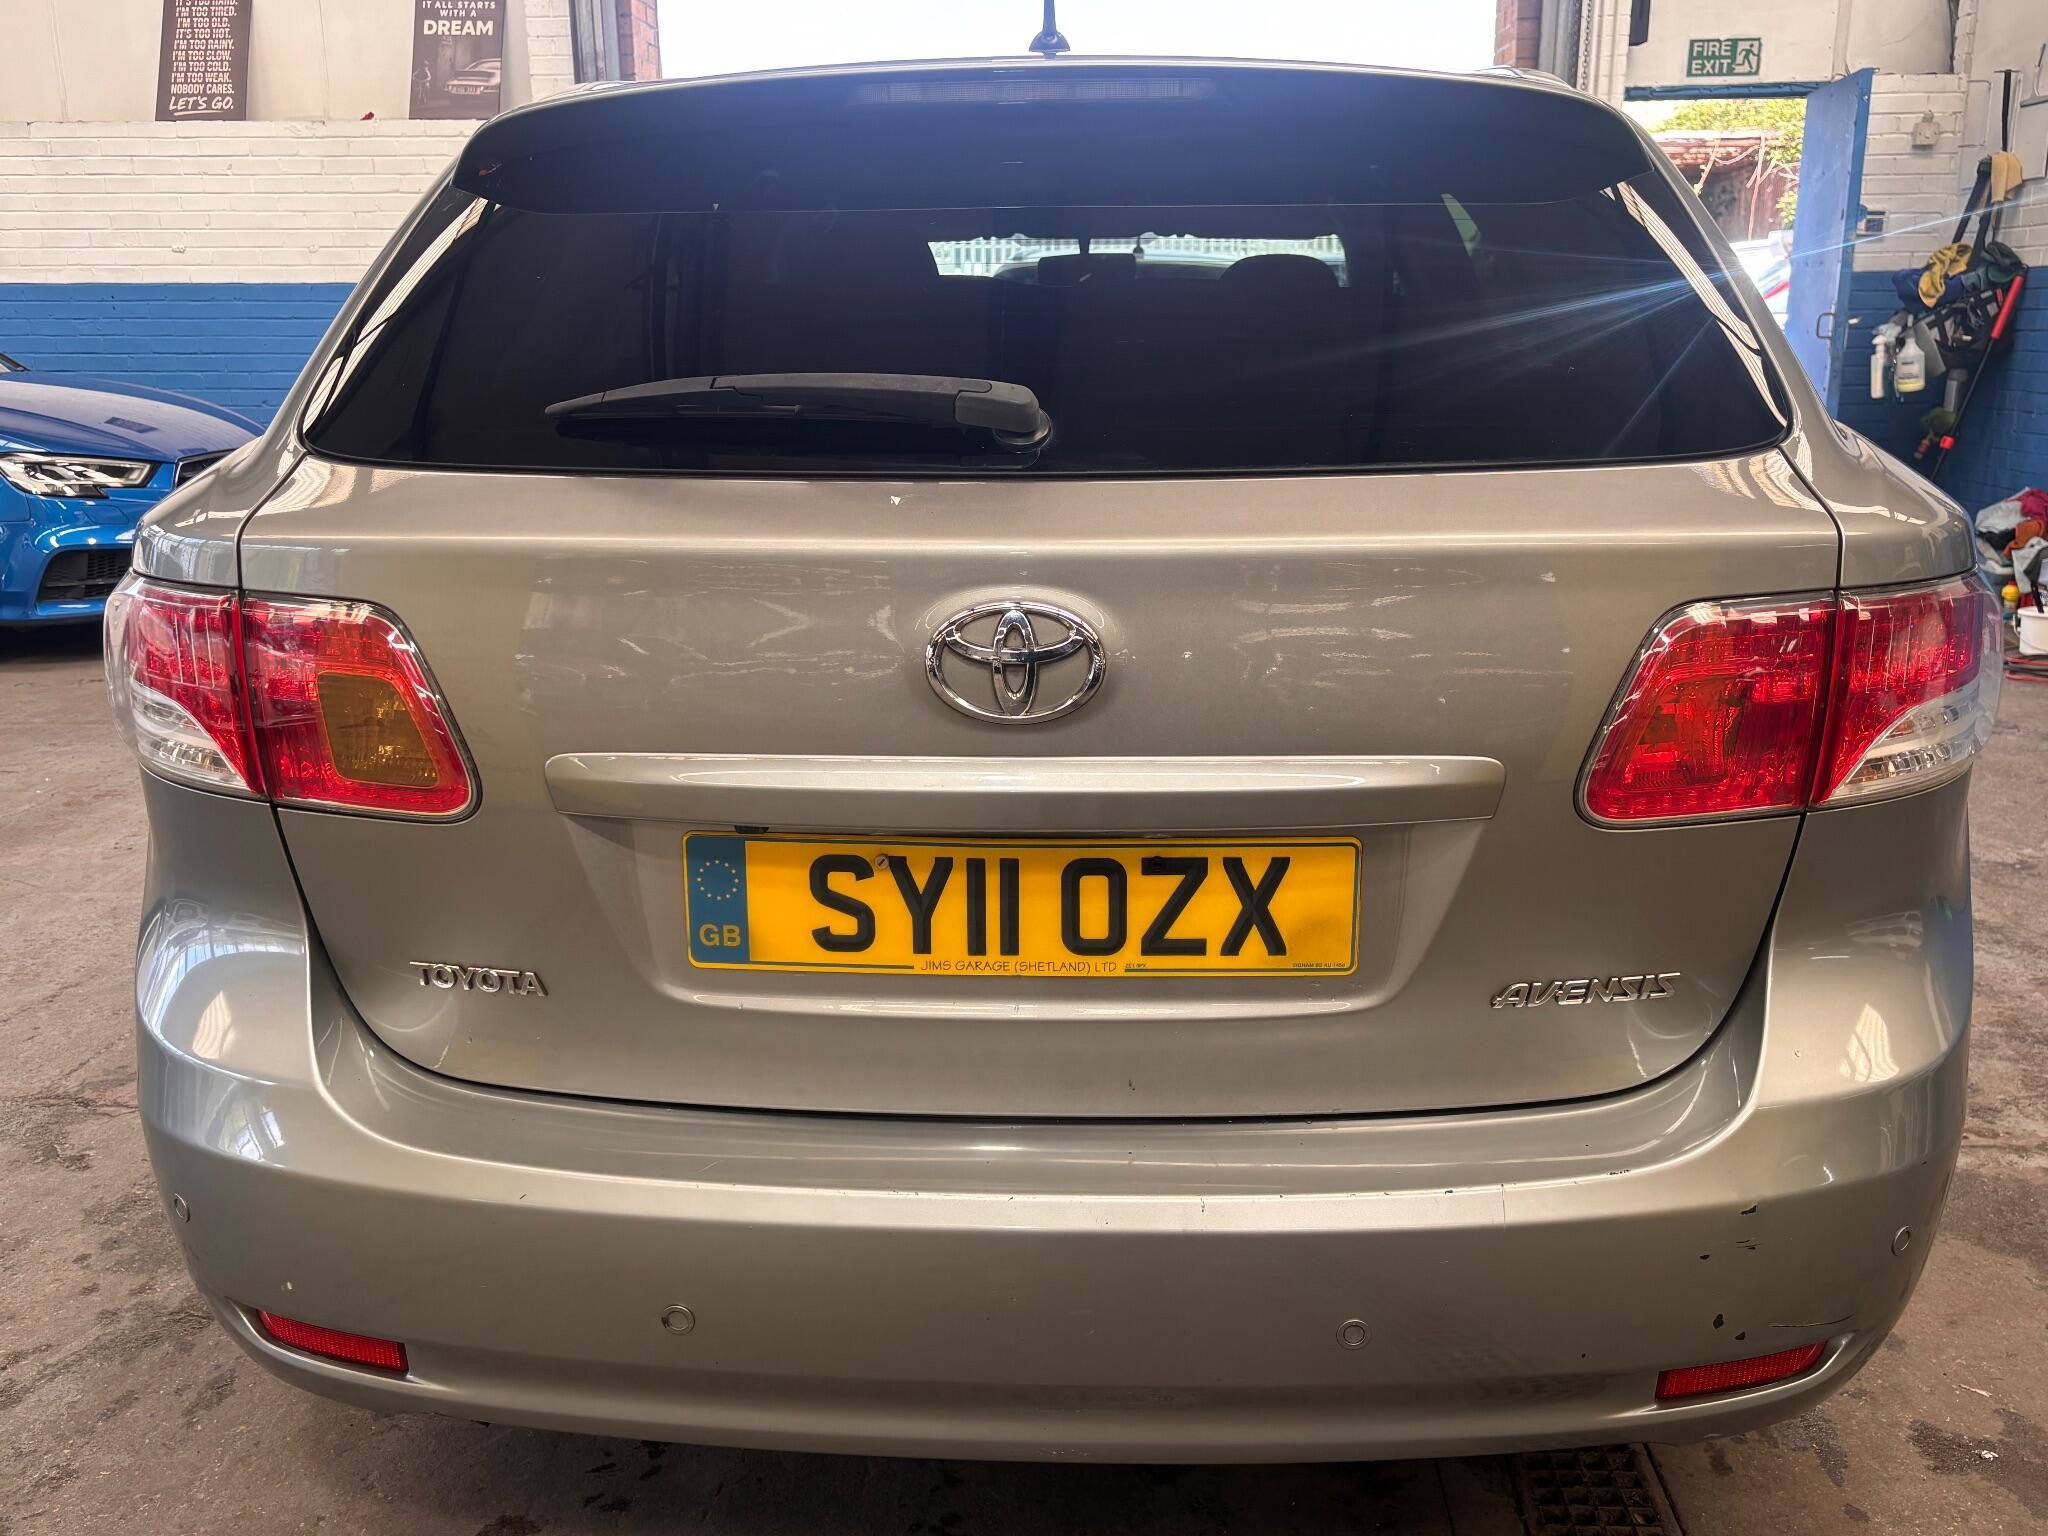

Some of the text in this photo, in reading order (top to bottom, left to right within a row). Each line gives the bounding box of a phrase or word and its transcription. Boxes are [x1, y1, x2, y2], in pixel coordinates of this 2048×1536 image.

[422, 1, 496, 9] IT ALL STARTS
[176, 6, 237, 17] I'M TOO TIRED.
[440, 9, 466, 17] WITH
[177, 17, 231, 28] I'M TOO OLD.
[423, 19, 494, 36] DREAM
[175, 28, 231, 39] IT'S TOO HOT.
[174, 39, 235, 50] I'M TOO RAINY.
[1693, 41, 1732, 57] FIRE
[172, 50, 232, 61] I'M TOO SLOW.
[173, 61, 231, 72] I'M TOO COLD.
[1691, 59, 1731, 74] EXIT
[171, 72, 232, 83] I'M TOO WEAK.
[170, 83, 235, 94] NOBODY CARES.
[169, 95, 234, 111] LET'S GO.
[807, 853, 1291, 958] SY11 OZX
[699, 923, 741, 947] GB
[920, 960, 952, 972] JIMS
[955, 960, 1011, 972] GARAGE
[1014, 960, 1091, 975] (SHETLAND)
[1094, 961, 1117, 973] LTD
[409, 961, 549, 997] TOYOTA
[1490, 972, 1681, 1009] AVENSIS
